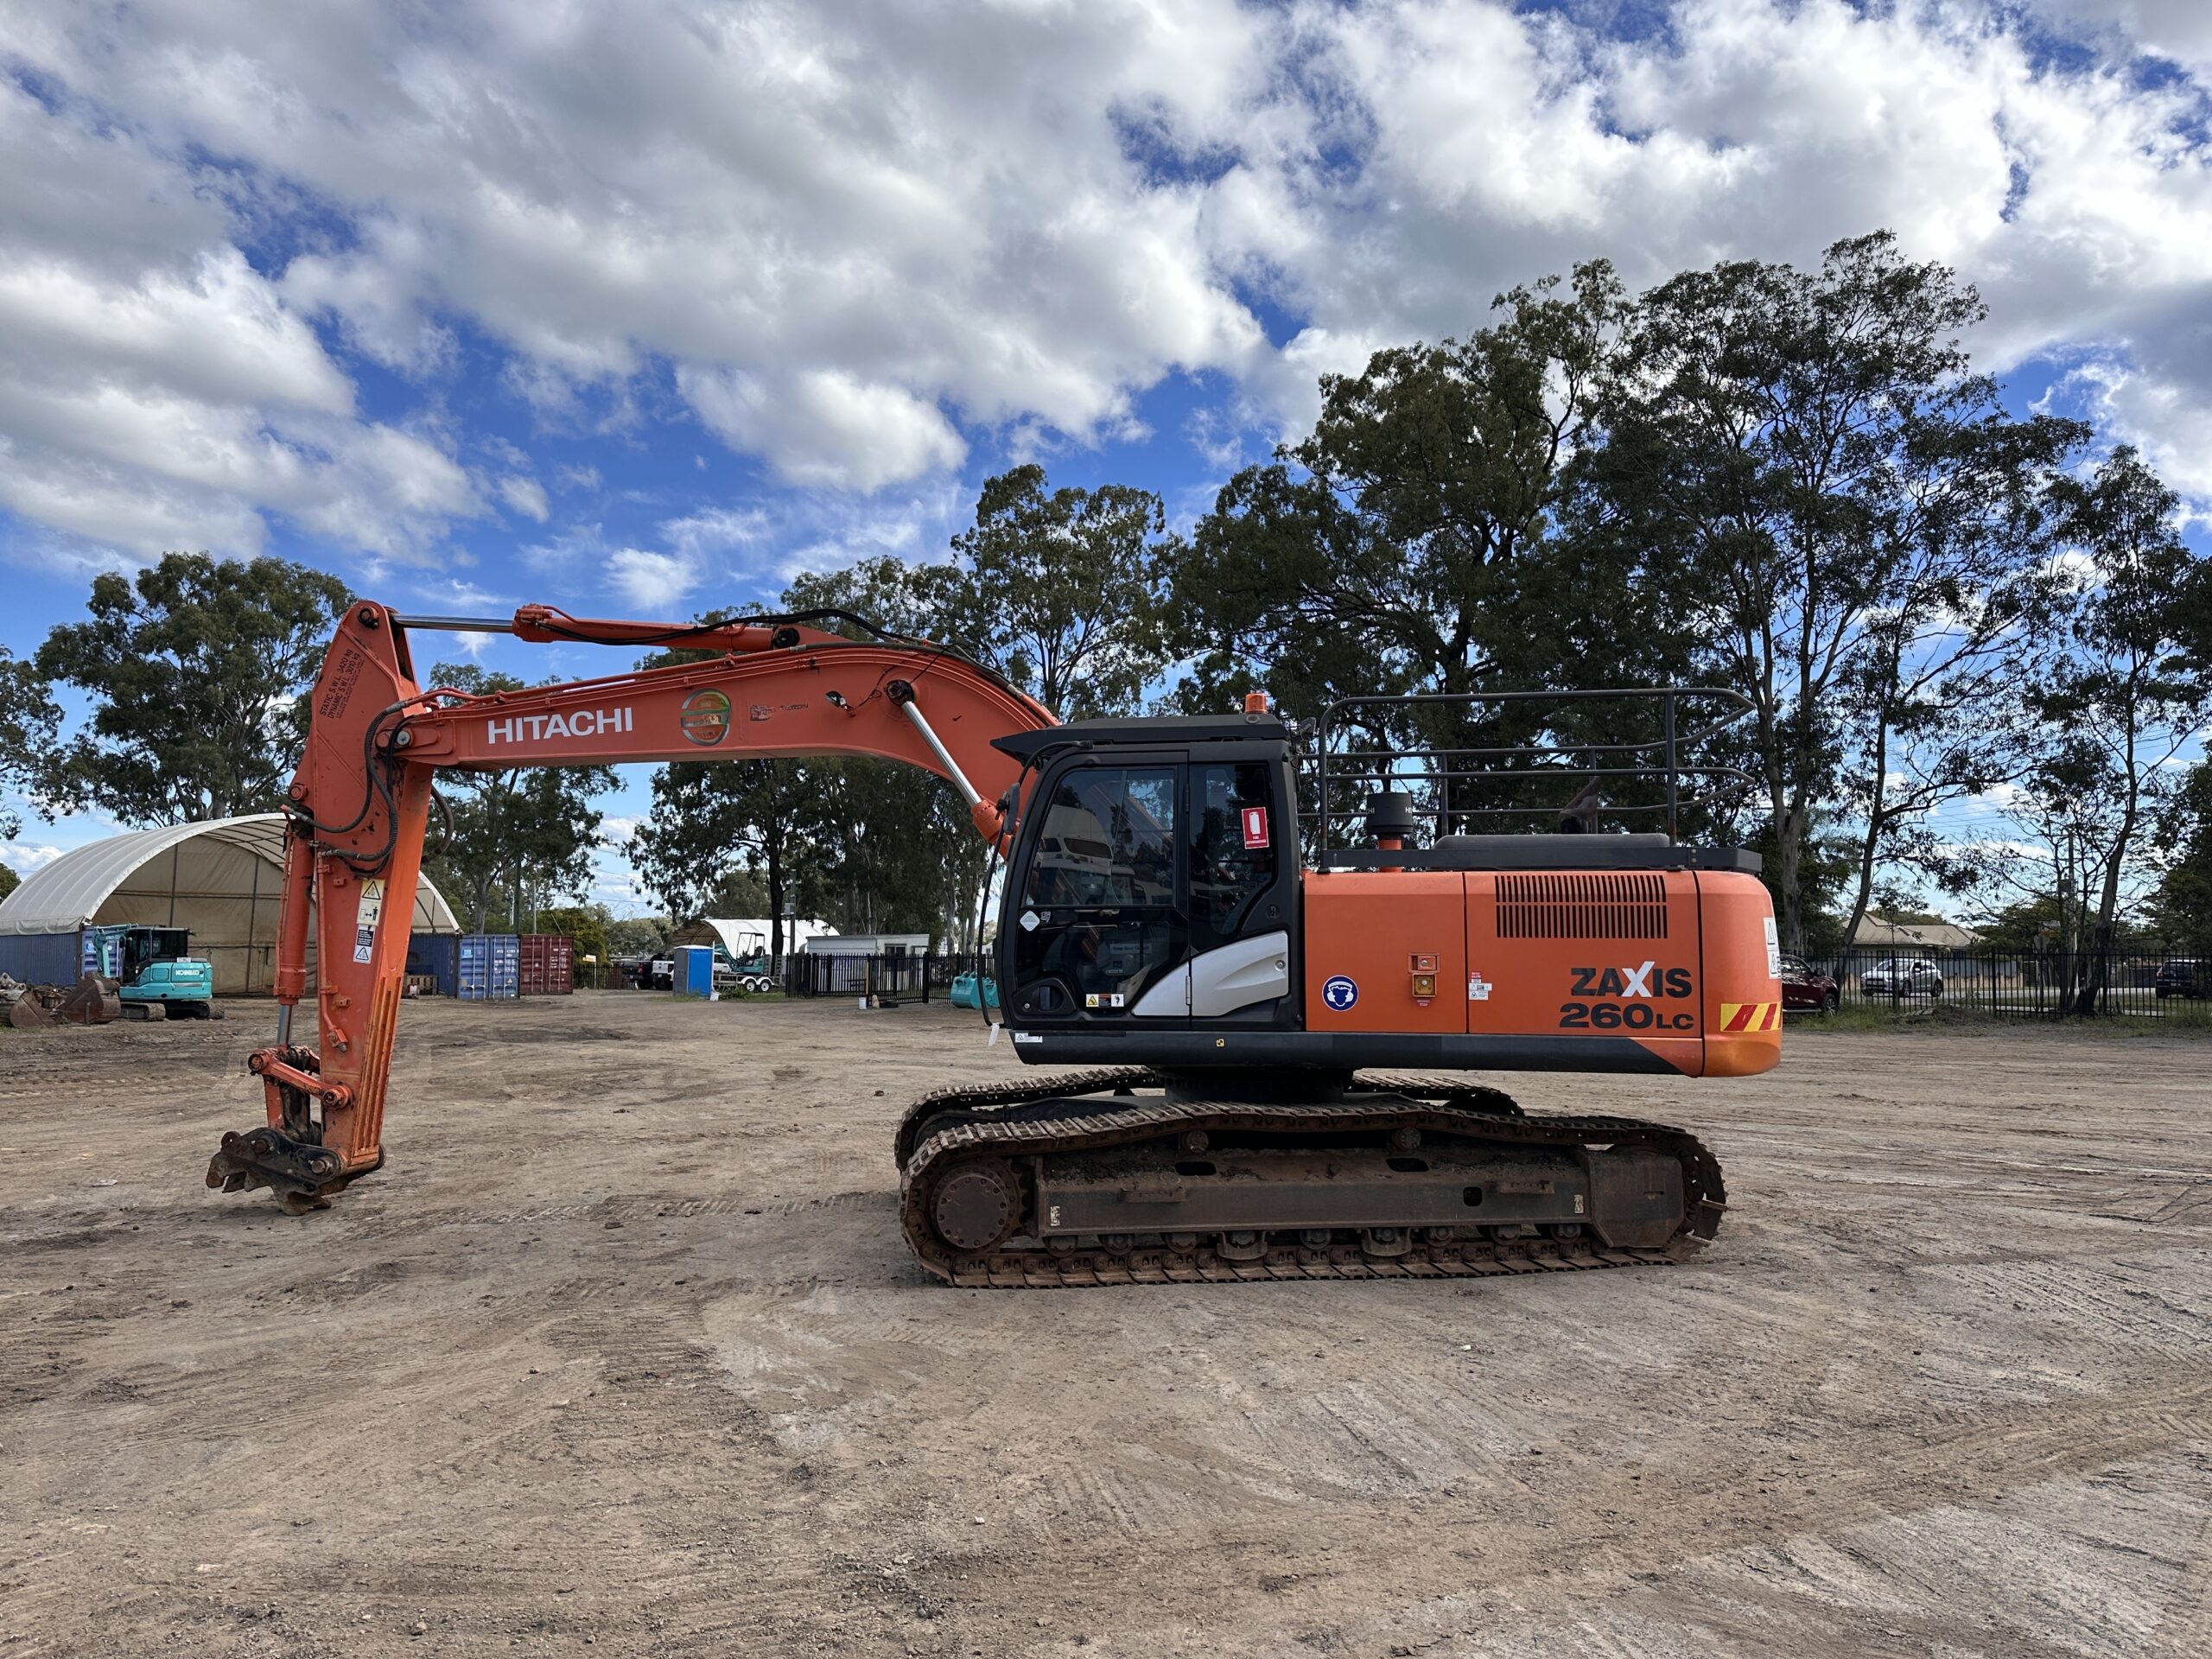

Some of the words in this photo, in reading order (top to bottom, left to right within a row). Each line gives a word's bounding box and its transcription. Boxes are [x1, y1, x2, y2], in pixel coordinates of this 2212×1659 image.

[320, 694, 333, 715] STATIC
[338, 658, 348, 673] 3420
[327, 692, 343, 719] DYNAMIC
[487, 707, 632, 744] HITACHI
[1571, 961, 1693, 998] ZAXIS
